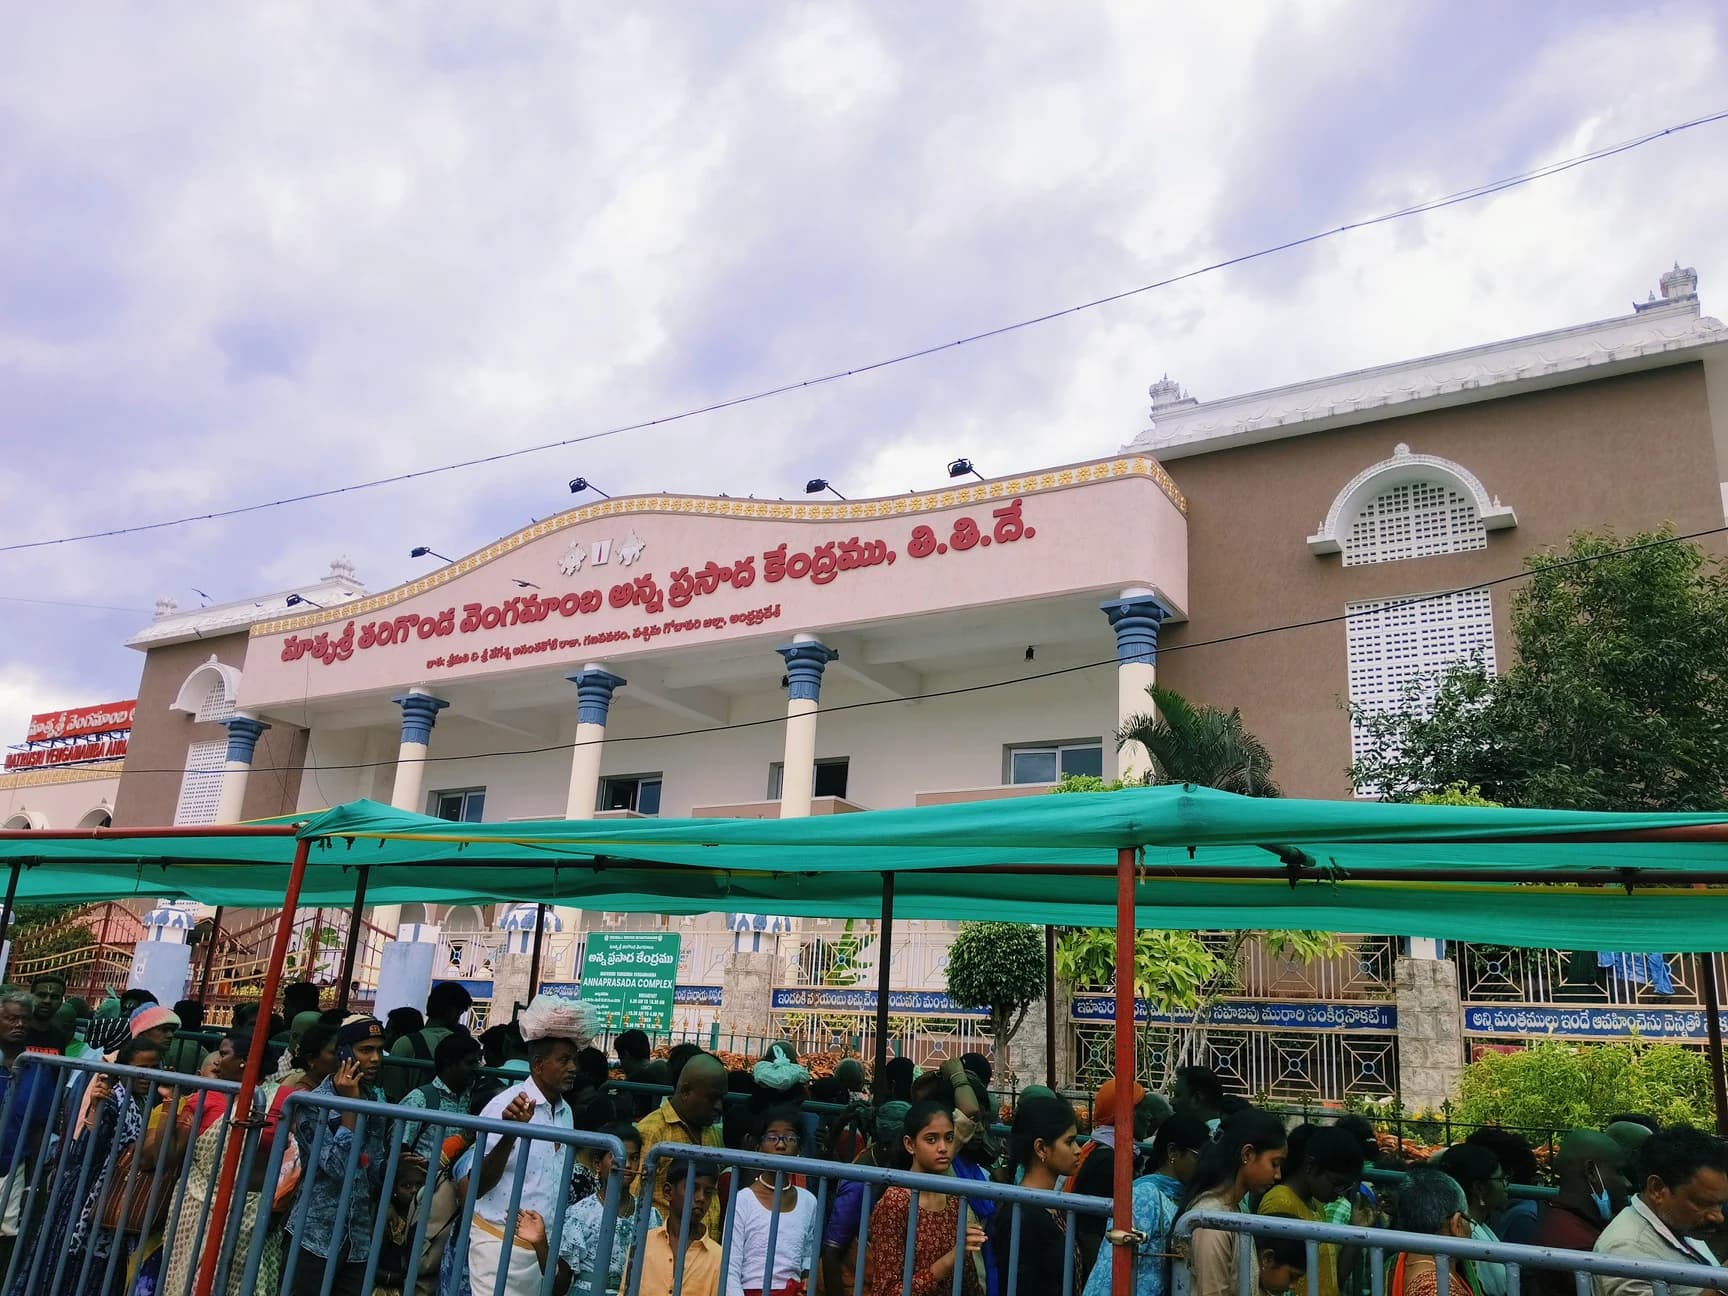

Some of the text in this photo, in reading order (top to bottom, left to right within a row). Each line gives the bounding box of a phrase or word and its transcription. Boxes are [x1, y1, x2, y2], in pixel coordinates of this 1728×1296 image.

[460, 588, 602, 633] వెంగమాంబ
[609, 573, 664, 614] అన్న
[668, 557, 755, 608] ప్రసాద
[588, 952, 607, 966] అన్న
[608, 952, 634, 966] ప్రసాద
[636, 950, 674, 966] కేంద్రము
[583, 976, 672, 989] ANNAPRASADA COMPLEX
[1213, 1004, 1258, 1022] సహజపు
[1262, 1006, 1306, 1023] మురారి
[1472, 1012, 1494, 1032] అన్ని
[1495, 1011, 1558, 1032] మంత్రములు
[1561, 1010, 1590, 1029] ఇందే
